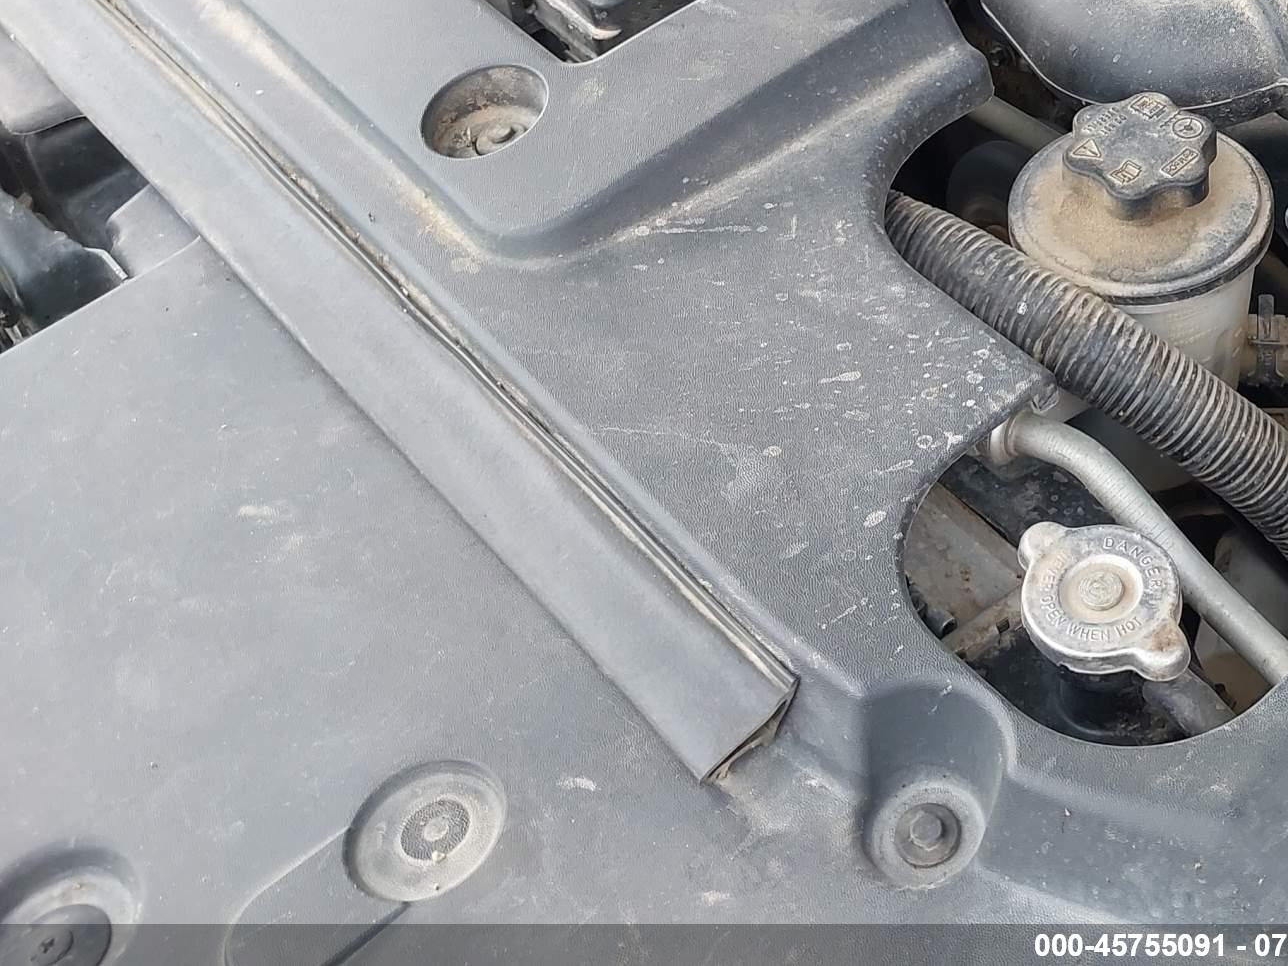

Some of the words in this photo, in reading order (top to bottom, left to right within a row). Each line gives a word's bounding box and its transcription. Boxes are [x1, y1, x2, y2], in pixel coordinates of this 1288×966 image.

[1040, 551, 1070, 592] NEVER
[1102, 536, 1164, 589] DANGER
[1040, 594, 1069, 628] OPEN
[1115, 615, 1144, 638] HOT
[1067, 623, 1112, 642] WHEN
